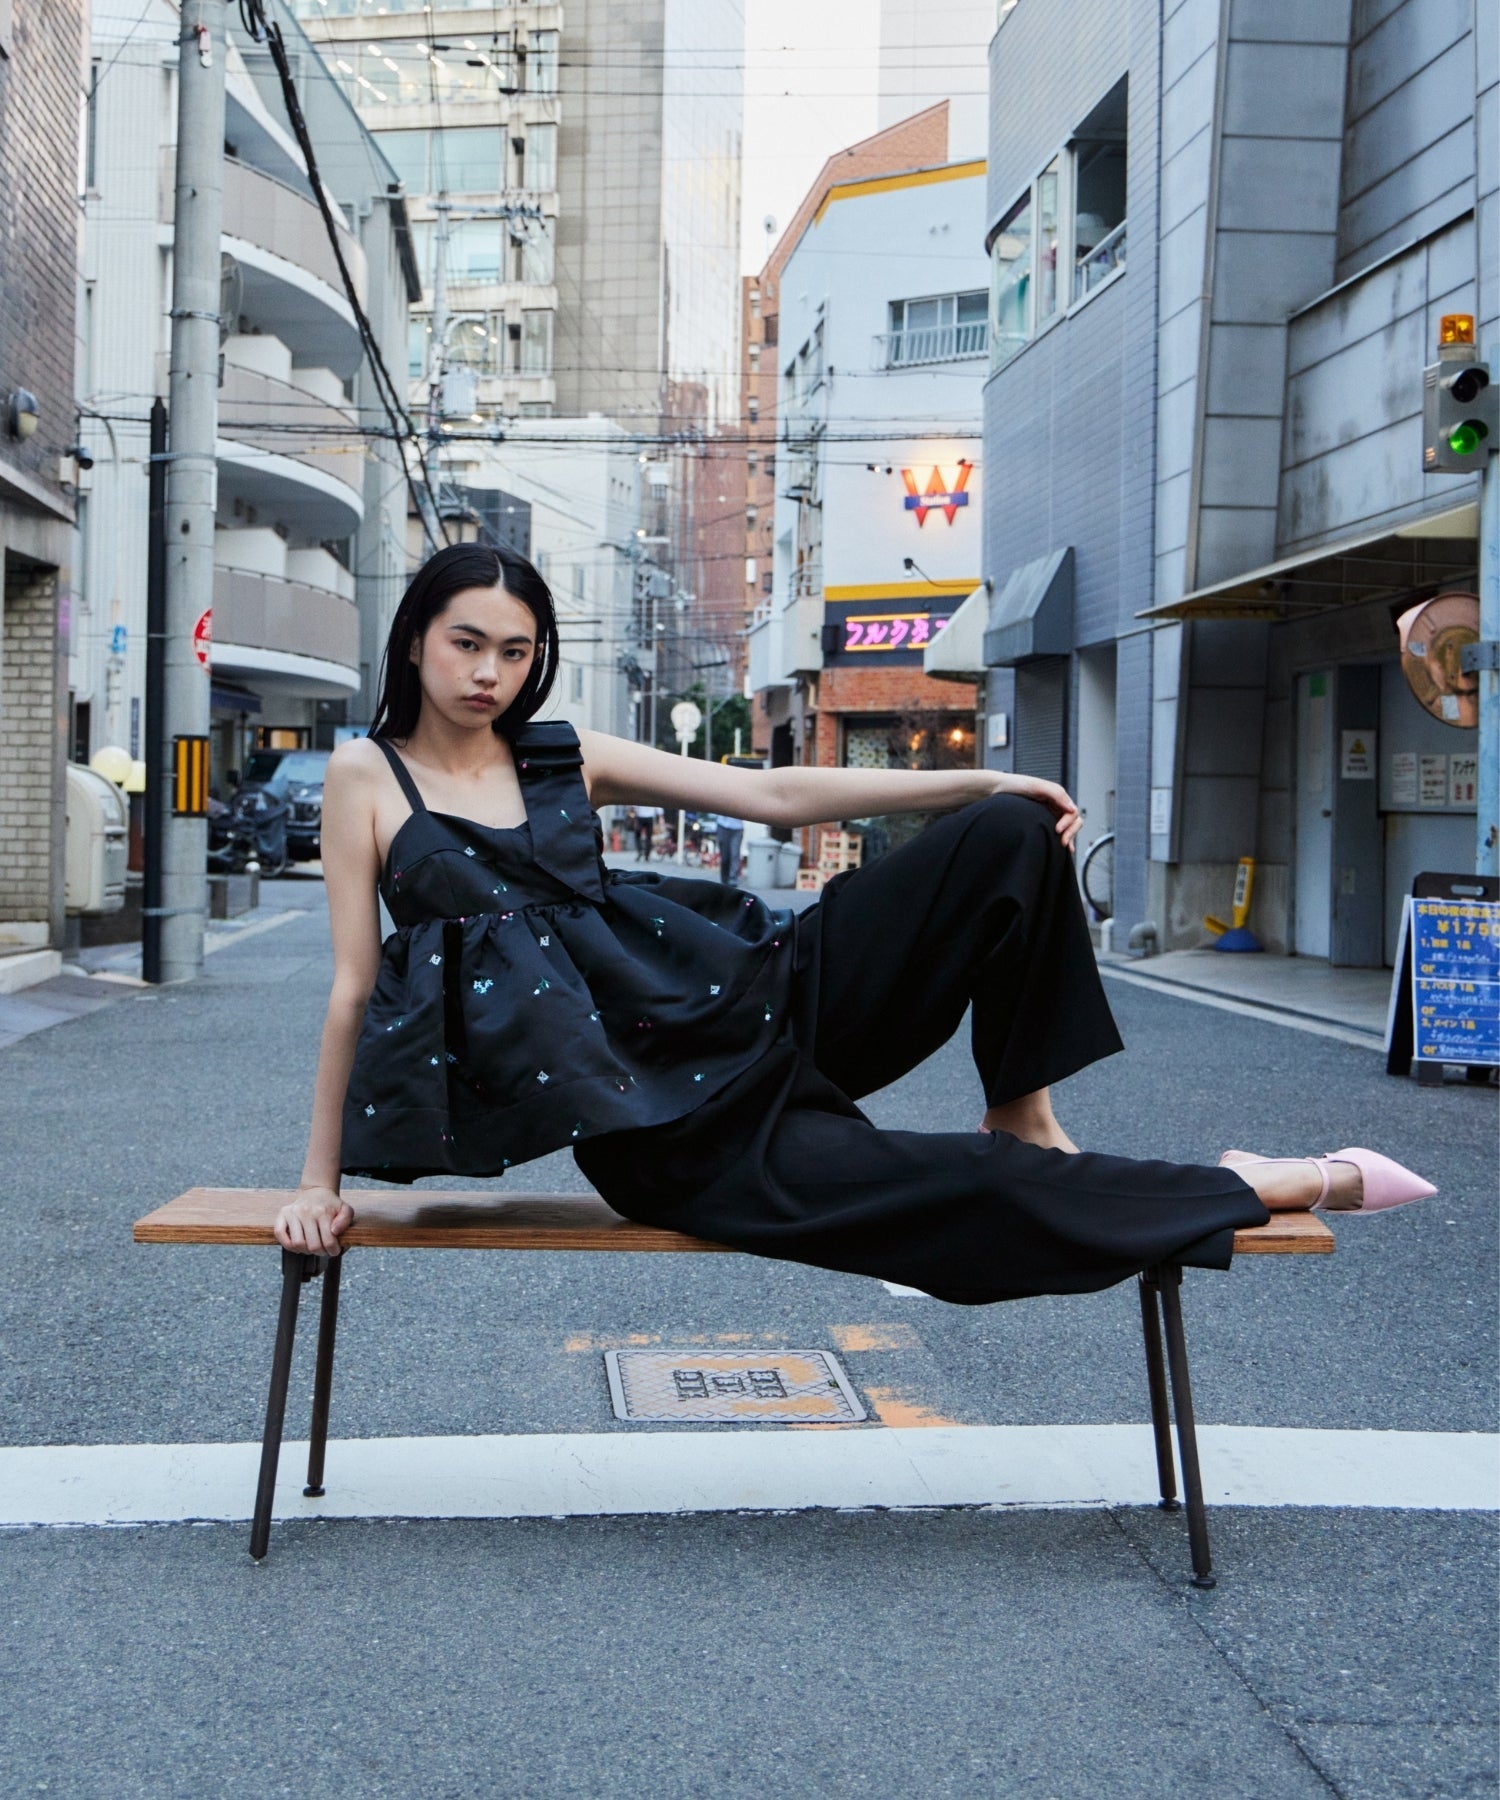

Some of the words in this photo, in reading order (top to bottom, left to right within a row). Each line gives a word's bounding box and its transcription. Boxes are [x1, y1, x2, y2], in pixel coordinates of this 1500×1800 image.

[1420, 963, 1436, 974] or
[1421, 1005, 1437, 1016] or
[1422, 1044, 1438, 1055] or
